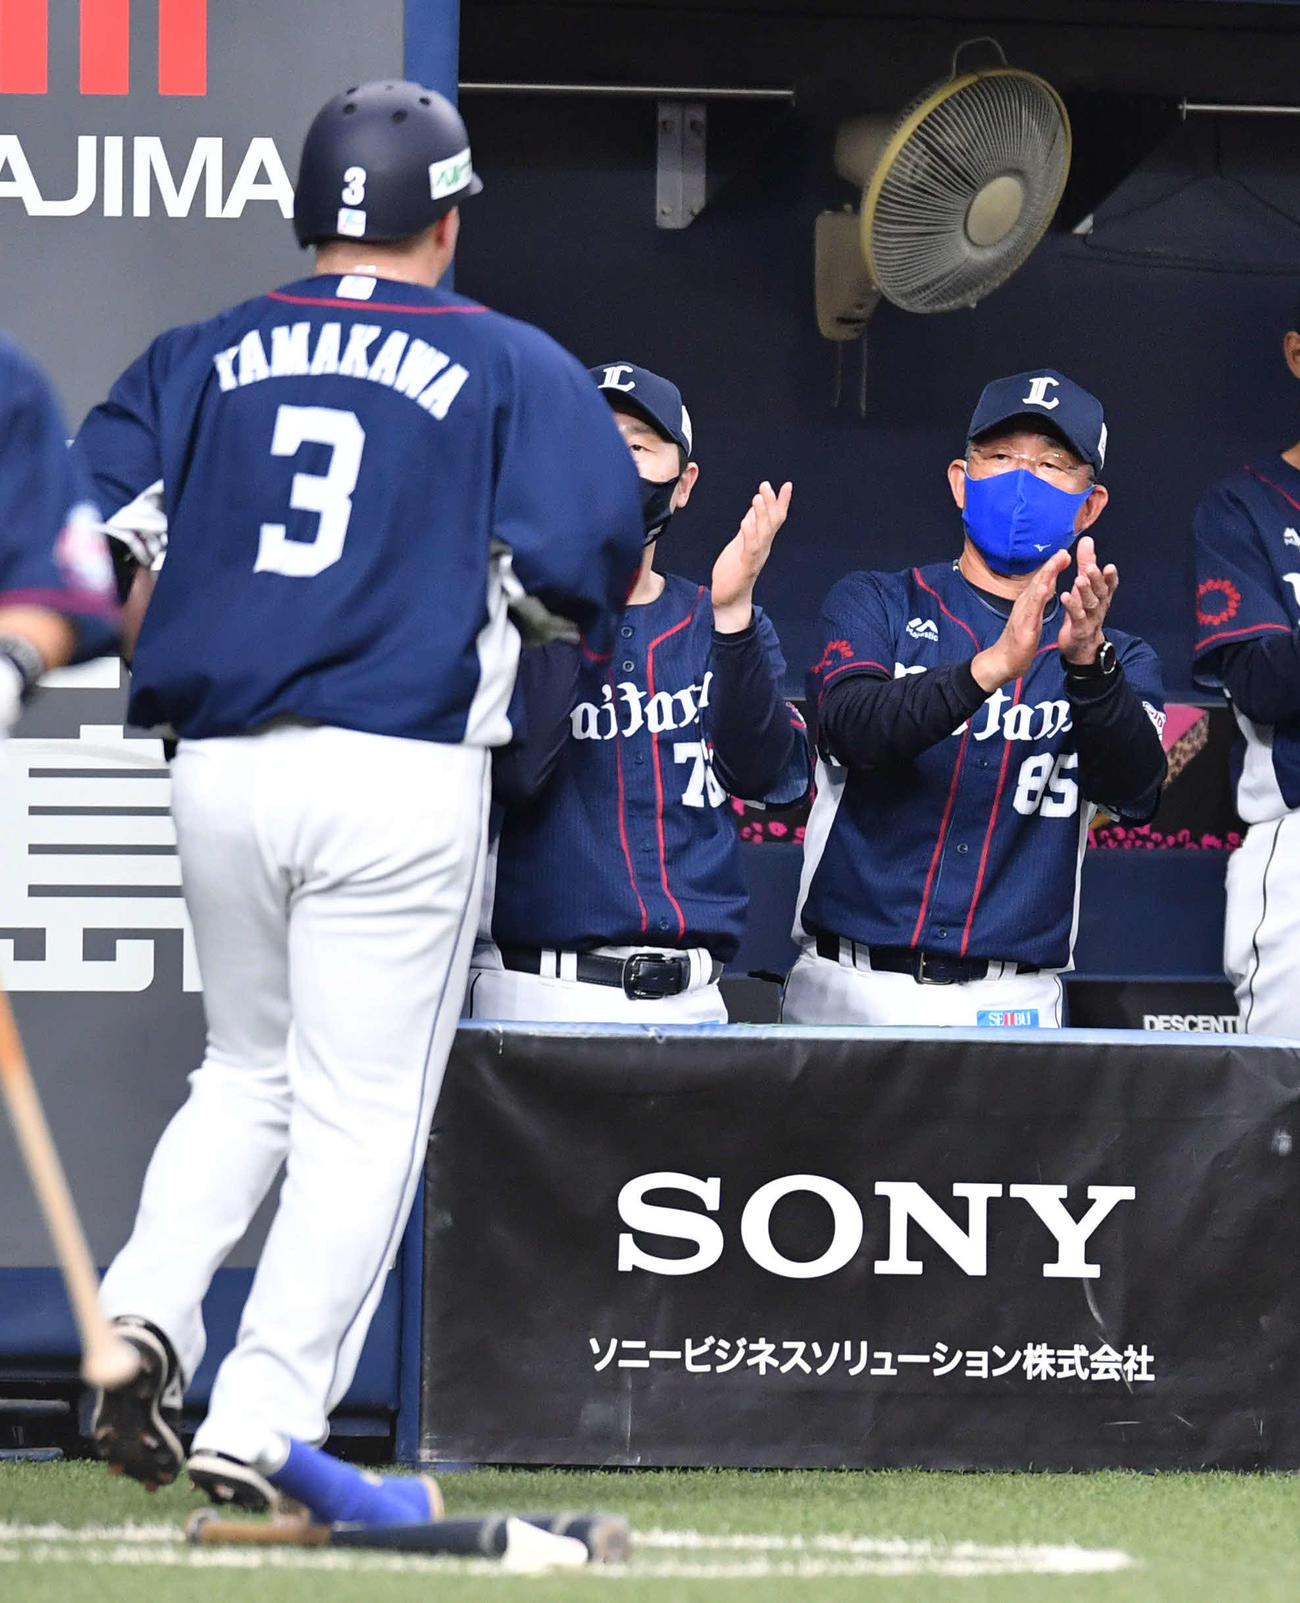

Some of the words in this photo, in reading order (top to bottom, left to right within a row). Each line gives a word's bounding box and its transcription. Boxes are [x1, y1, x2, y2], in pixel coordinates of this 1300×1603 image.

[341, 166, 367, 206] 3
[213, 321, 470, 421] YAMAKAWA
[597, 364, 636, 392] L
[1022, 376, 1060, 410] L
[253, 403, 366, 577] 3
[1012, 752, 1079, 818] 85
[988, 1010, 1031, 1026] SEIBU
[1143, 1014, 1241, 1034] DESCENT
[616, 1171, 1136, 1279] SONY
[589, 1335, 1156, 1382] ソニービジネスソリューション株式会社
